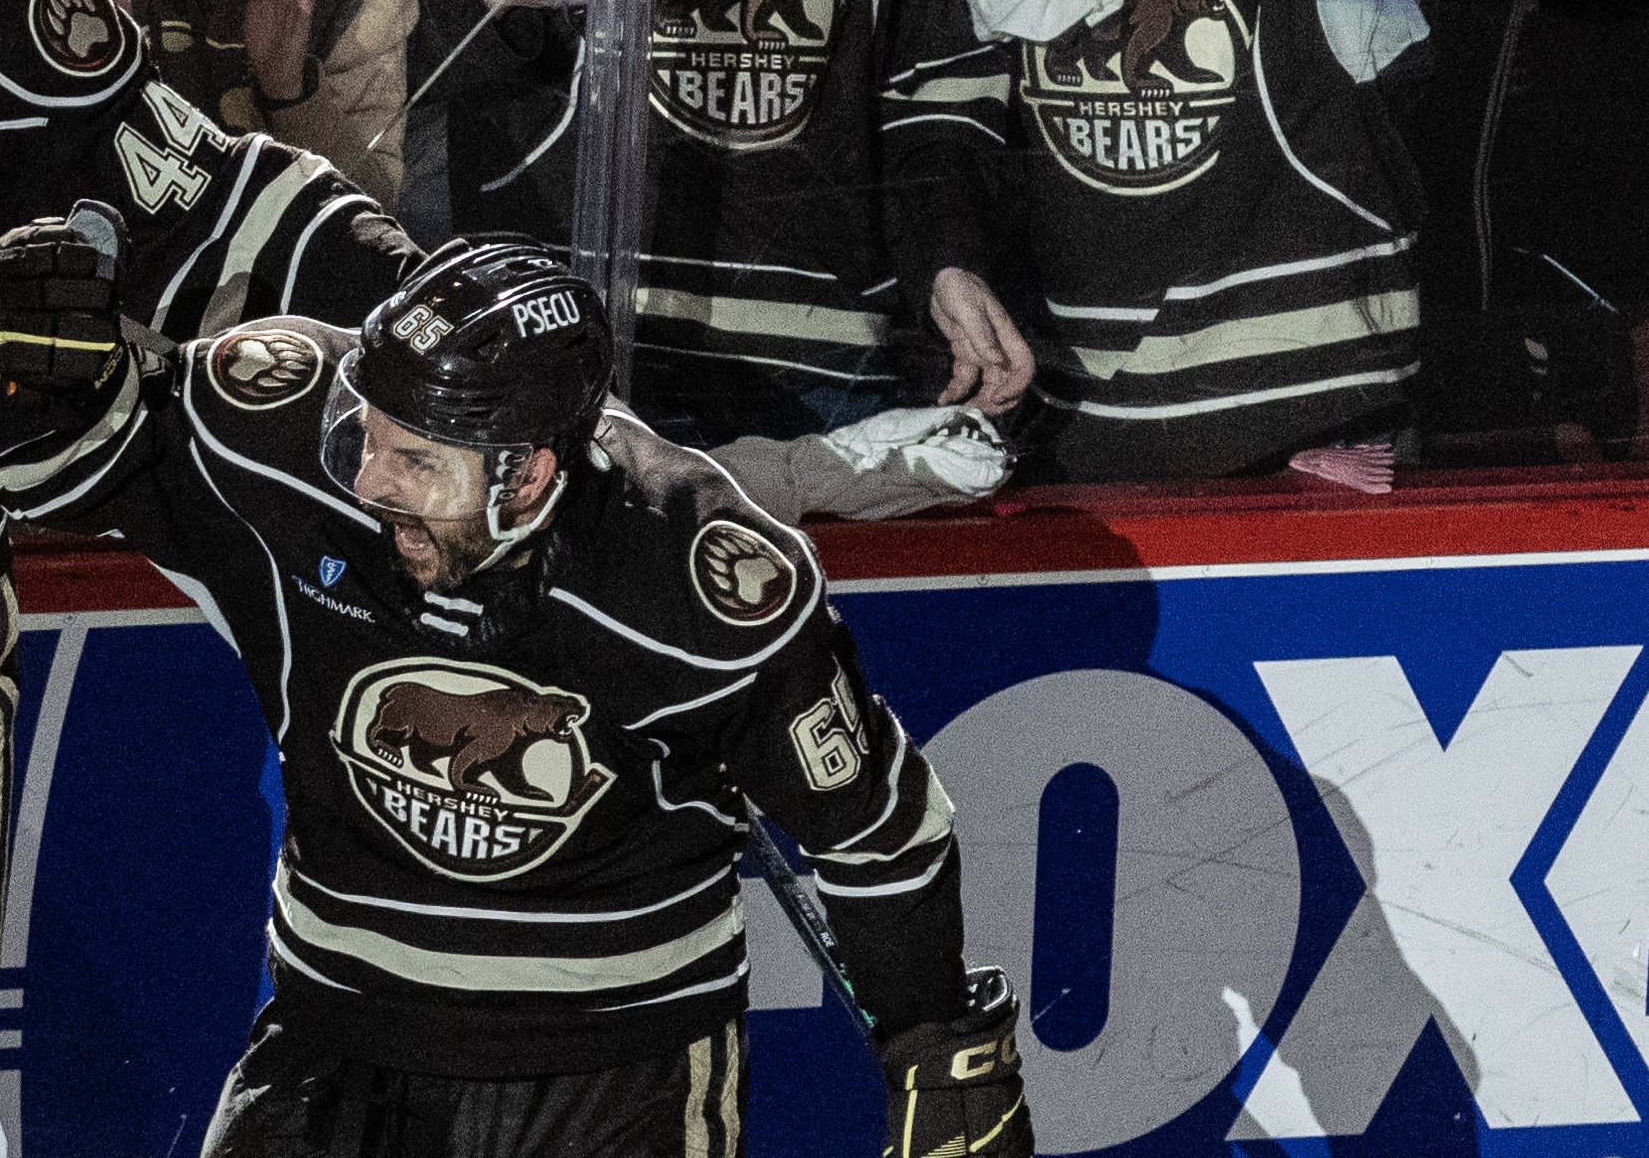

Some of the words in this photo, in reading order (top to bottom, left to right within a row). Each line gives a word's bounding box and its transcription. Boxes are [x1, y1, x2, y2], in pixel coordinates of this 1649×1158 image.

[690, 51, 797, 71] HERSHEY
[675, 69, 808, 125] BEARS
[1079, 100, 1184, 118] HERSHEY
[114, 80, 229, 215] 44
[1065, 116, 1204, 171] BEARS
[392, 303, 456, 356] 65
[512, 291, 581, 338] PSECU
[380, 784, 527, 861] BEARS
[397, 780, 510, 823] HERSHEY
